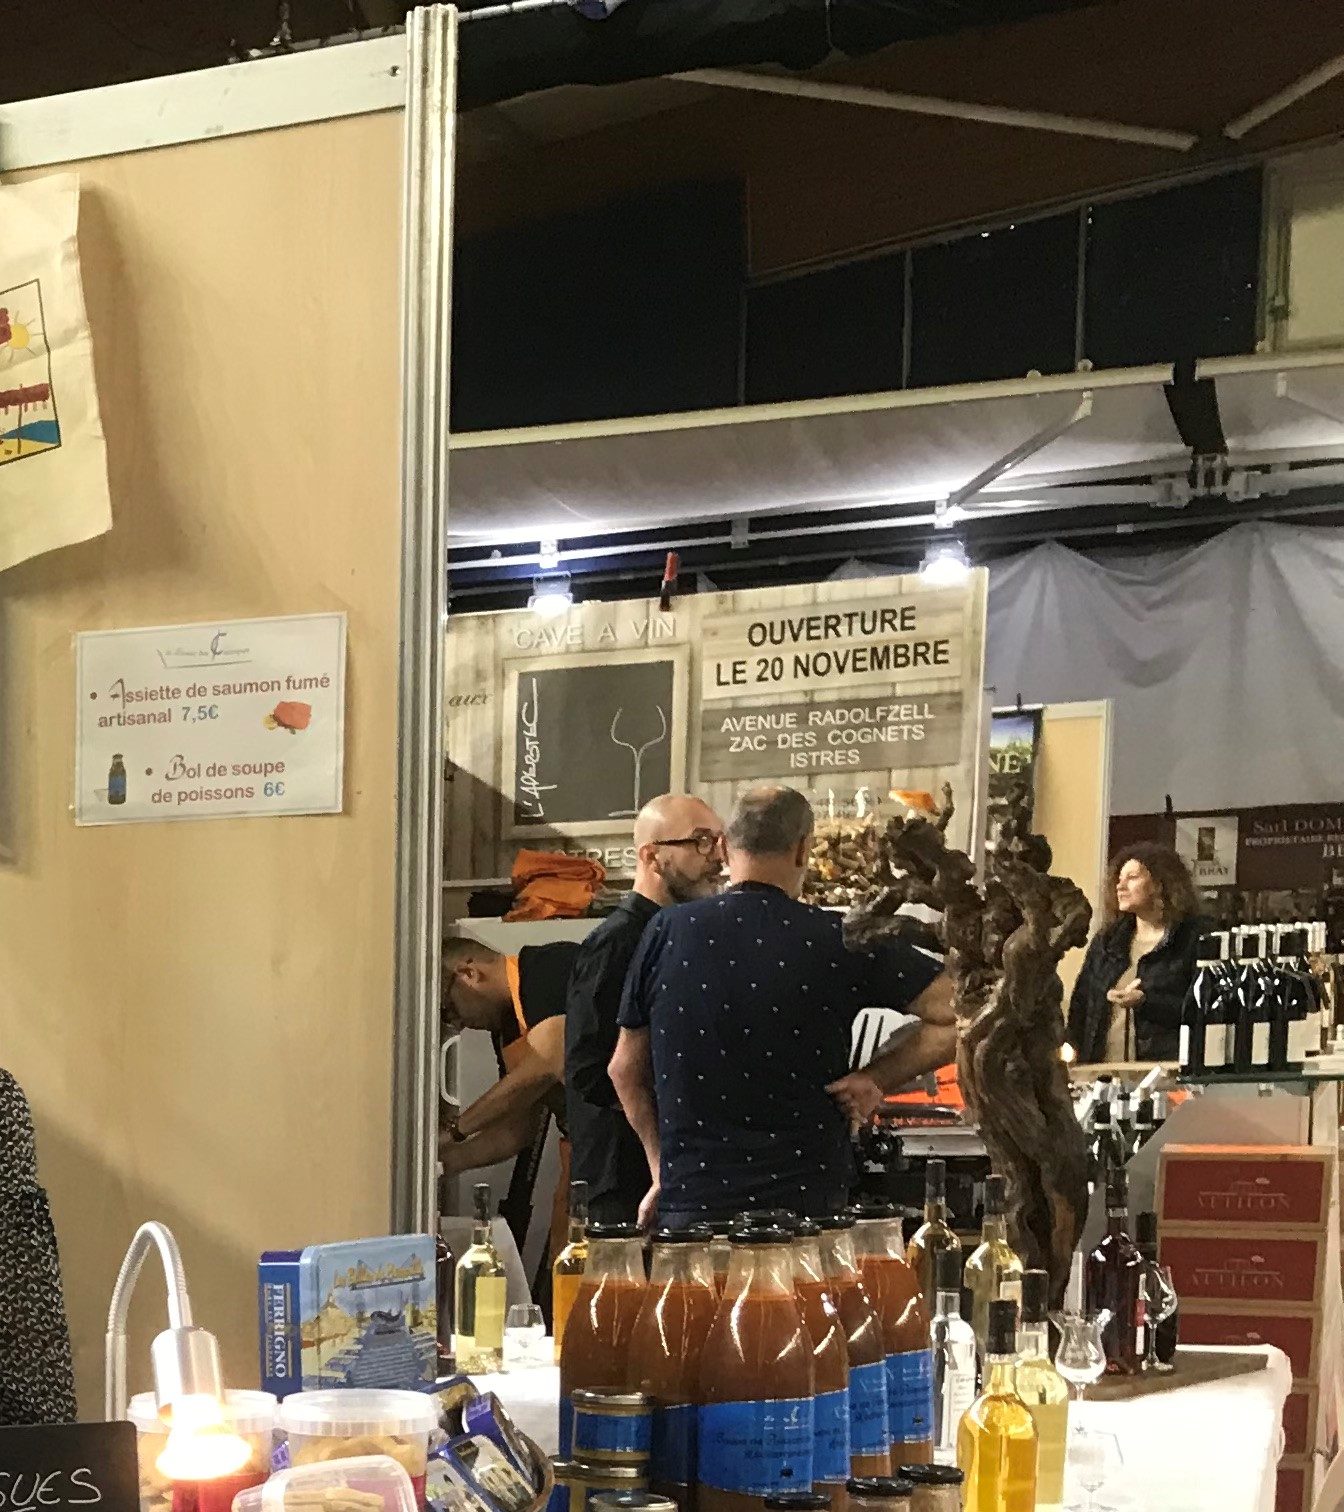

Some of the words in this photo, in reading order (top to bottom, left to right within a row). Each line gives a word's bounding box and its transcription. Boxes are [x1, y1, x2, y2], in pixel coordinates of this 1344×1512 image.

[515, 624, 583, 651] CAVE
[597, 621, 617, 643] A
[629, 617, 676, 640] VIN
[747, 605, 917, 647] OUVERTURE
[716, 658, 747, 688] LE
[756, 657, 784, 683] 20
[792, 639, 950, 680] NOVEMBRE
[109, 677, 182, 709] Assiette
[186, 682, 208, 699] de
[212, 678, 282, 696] saumon
[285, 673, 331, 691] fumé
[98, 707, 173, 729] artisanal
[721, 711, 799, 734] AVENUE
[808, 702, 936, 727] RADOLFZELL
[729, 733, 767, 752] ZAC
[776, 730, 818, 750] DES
[828, 723, 925, 747] COGNETS
[165, 754, 202, 781] Bol
[205, 762, 228, 778] de
[231, 760, 286, 781] soupe
[790, 747, 861, 769] ISTRES
[151, 788, 173, 804] de
[177, 785, 255, 806] poissons
[263, 782, 286, 797] 6€
[273, 1283, 286, 1378] FERRIGNO
